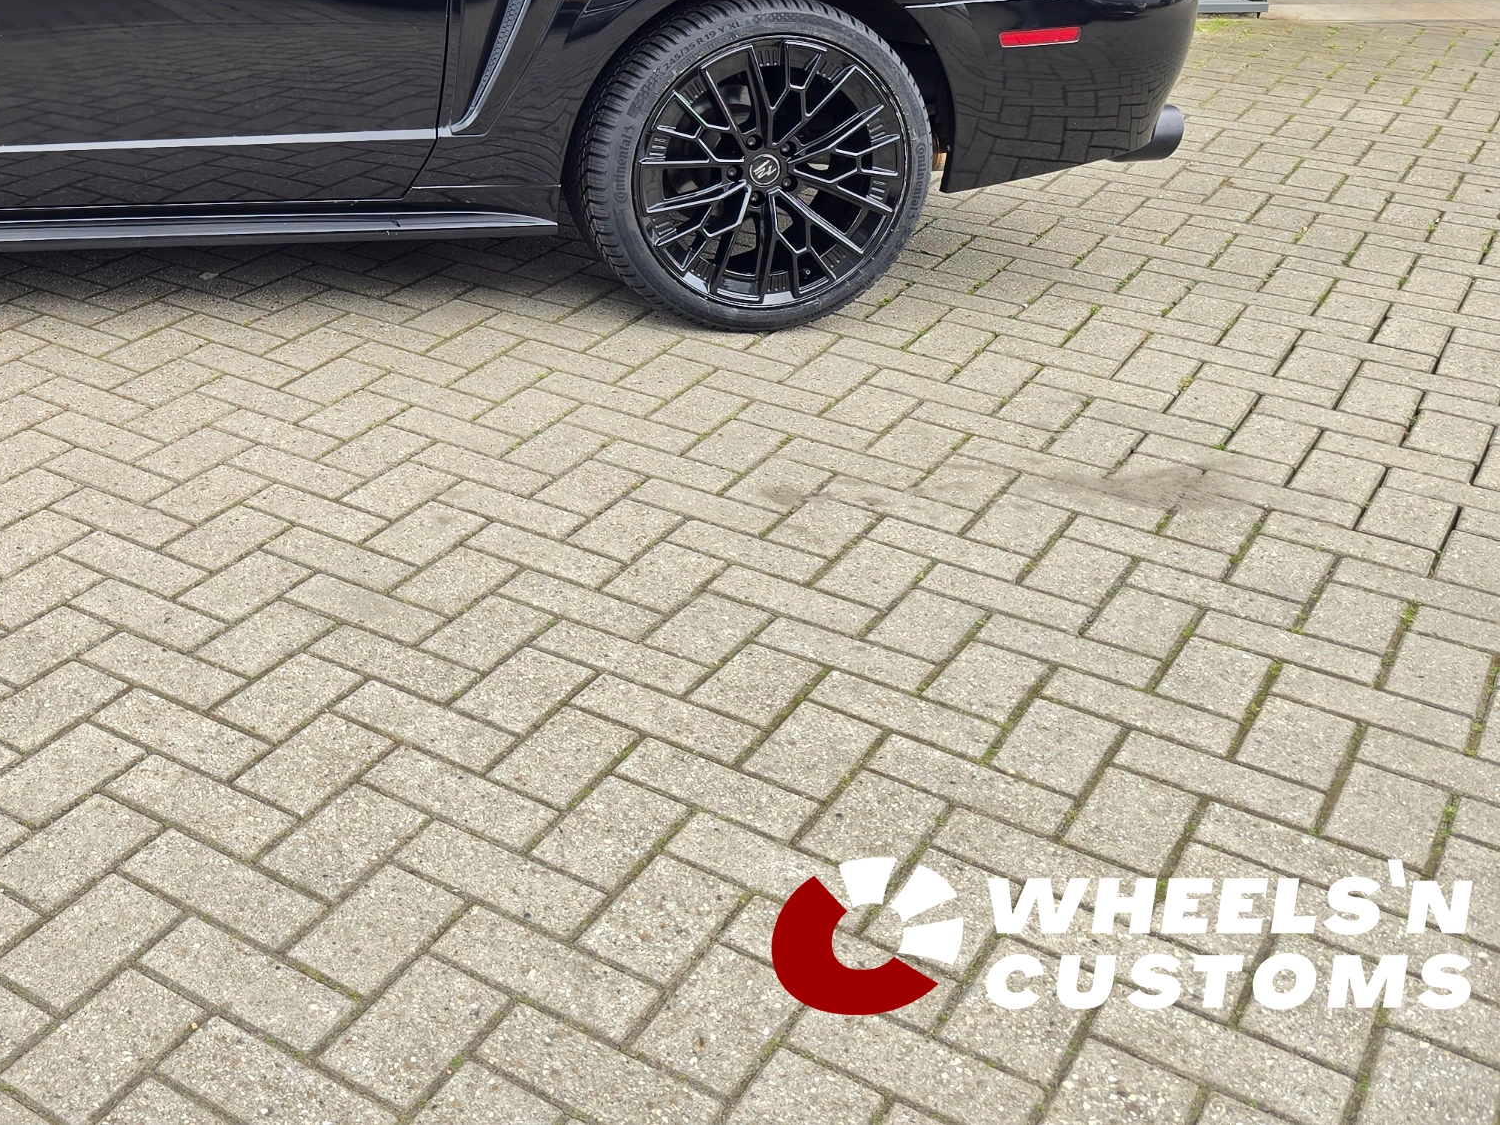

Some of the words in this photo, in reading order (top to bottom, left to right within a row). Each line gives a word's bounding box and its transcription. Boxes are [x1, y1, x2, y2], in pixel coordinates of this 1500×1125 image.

[663, 43, 696, 70] 245/35
[614, 134, 633, 204] Continental
[910, 142, 927, 211] Continental
